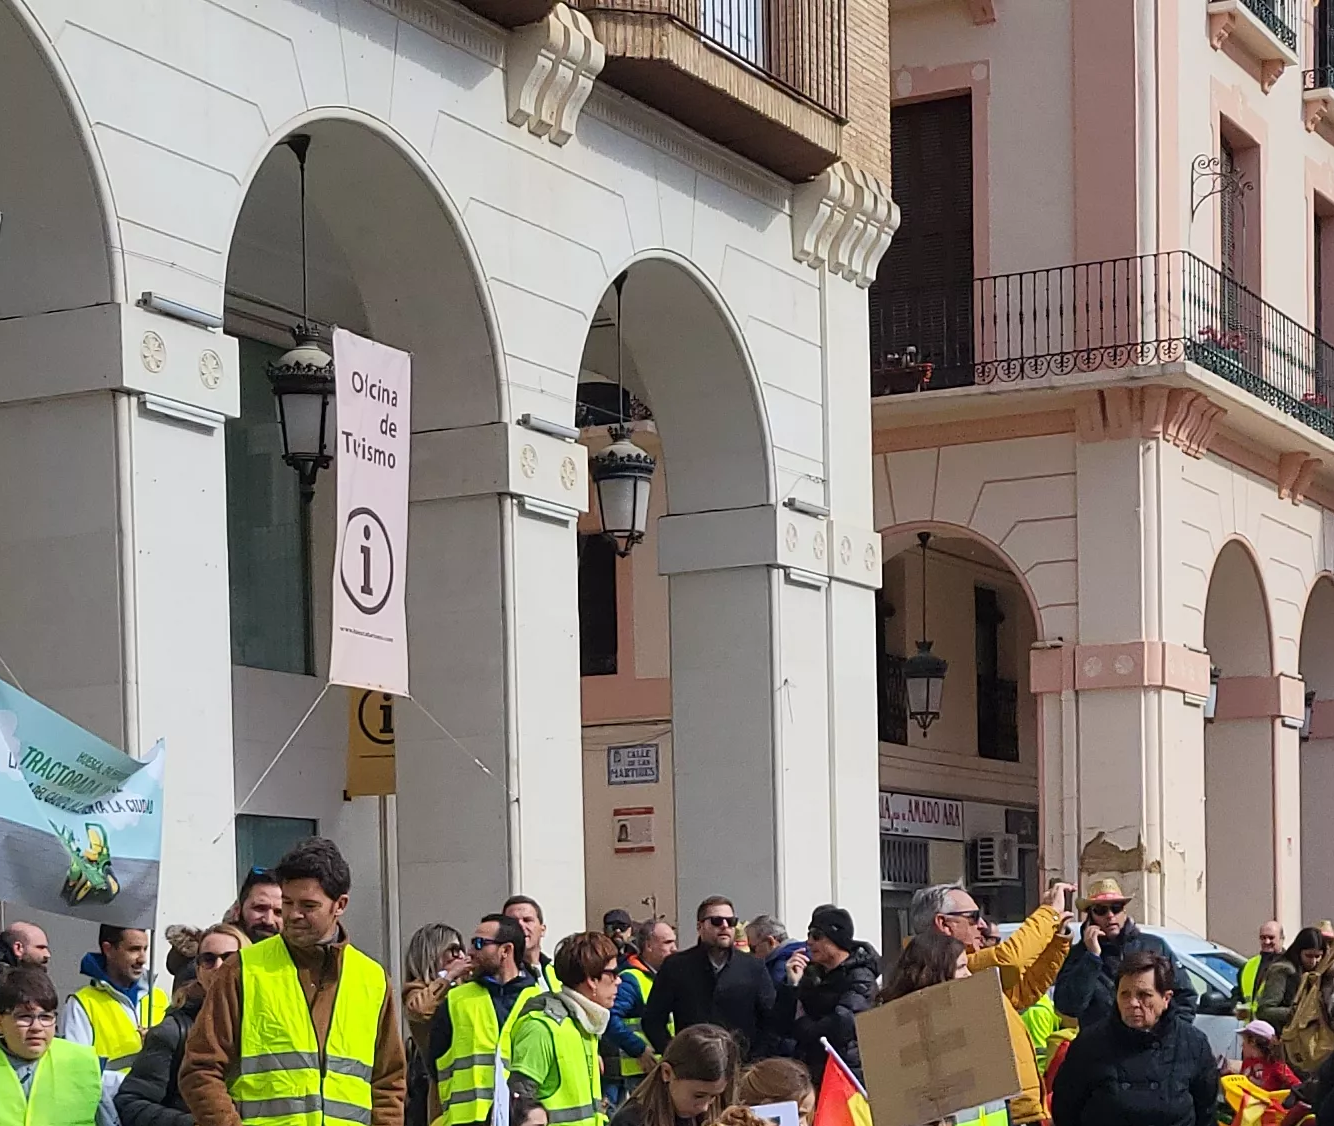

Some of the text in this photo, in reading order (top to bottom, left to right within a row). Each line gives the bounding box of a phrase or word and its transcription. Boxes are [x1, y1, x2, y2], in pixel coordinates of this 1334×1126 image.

[380, 413, 397, 438] de
[908, 799, 940, 824] AMADO
[943, 803, 961, 826] ARA
